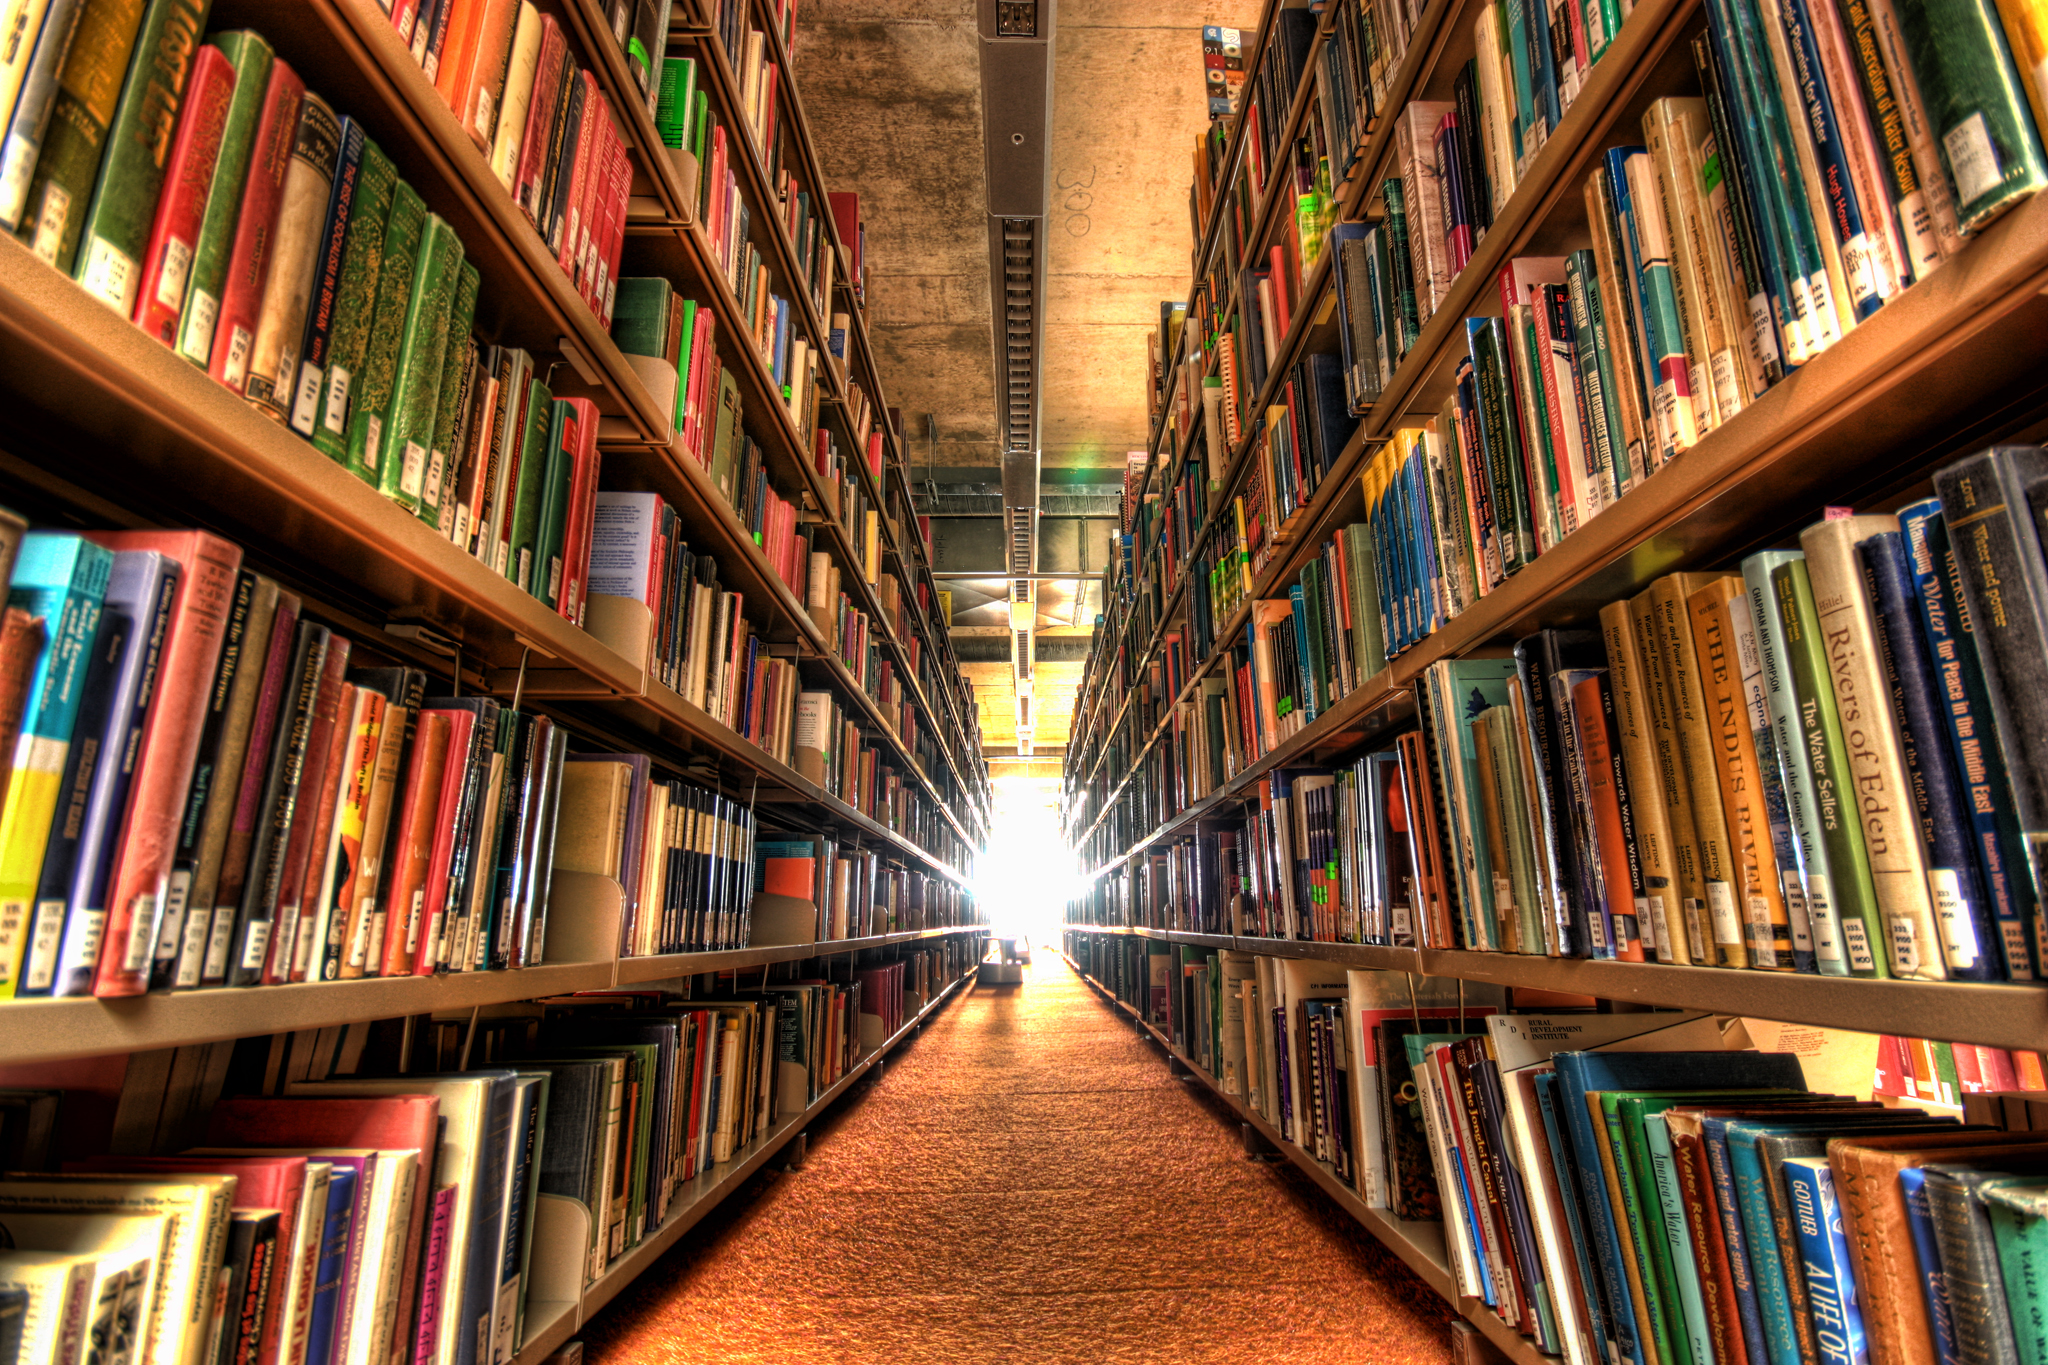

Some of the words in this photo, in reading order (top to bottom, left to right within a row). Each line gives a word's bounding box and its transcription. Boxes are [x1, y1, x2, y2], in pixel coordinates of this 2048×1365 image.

[1847, 0, 1871, 27] and
[1785, 23, 1814, 85] Planning
[1854, 21, 1893, 100] Conservation
[1802, 79, 1819, 103] for
[1875, 95, 1898, 114] of
[1807, 99, 1830, 144] Water
[1879, 108, 1909, 151] Water
[343, 162, 356, 181] THE
[1404, 157, 1417, 207] WATER
[1823, 163, 1844, 200] Hugh
[338, 180, 352, 203] RISE
[335, 203, 348, 219] OF
[1410, 208, 1420, 231] IN
[1832, 197, 1855, 241] Howes
[324, 219, 345, 275] SOCIALISM
[1412, 233, 1425, 283] CRISIS
[322, 275, 335, 288] IN
[313, 288, 332, 330] BRITAIN
[1588, 288, 1601, 324] WATSAN
[1595, 324, 1605, 350] 2000
[1533, 297, 1549, 362] RAINWATER
[1543, 363, 1561, 435] HARVESTING
[1587, 369, 1600, 395] WATER
[1573, 375, 1581, 394] First
[1576, 395, 1585, 422] People
[1591, 394, 1607, 437] RESOURCES
[1580, 424, 1588, 442] Poor
[1468, 409, 1478, 442] Designing
[1477, 469, 1486, 496] demand
[1583, 443, 1594, 473] Putting
[1903, 515, 1936, 575] Managing
[1972, 524, 1992, 562] Water
[1982, 561, 1999, 587] and
[235, 578, 254, 607] Left
[1751, 587, 1767, 626] CHAPMAN
[1816, 594, 1843, 609] Hillel
[1919, 574, 1952, 637] Water
[1985, 587, 2006, 629] power
[66, 609, 80, 633] and
[74, 600, 92, 640] Social
[86, 607, 99, 632] The
[233, 607, 247, 621] in
[1643, 614, 1653, 637] Water
[1663, 599, 1675, 624] Water
[59, 635, 74, 659] the
[228, 622, 244, 644] the
[1611, 625, 1621, 648] Water
[1648, 639, 1656, 653] and
[1668, 625, 1678, 641] and
[1759, 627, 1770, 645] AND
[1874, 613, 1899, 681] International
[1935, 638, 1957, 660] for
[1615, 649, 1624, 663] and
[1650, 655, 1661, 679] Power
[1671, 642, 1683, 668] Power
[1763, 646, 1780, 693] THOMPSON
[57, 642, 82, 703] Economy
[212, 644, 239, 712] Wilderness
[1618, 665, 1629, 689] Power
[1827, 625, 1867, 721] Rivers
[1940, 660, 1968, 701] Peace
[368, 695, 378, 714] David
[1602, 691, 1612, 714] IYER
[1655, 680, 1668, 719] Resources
[1676, 669, 1691, 710] Resources
[1705, 618, 1727, 685] THE
[1717, 693, 1746, 793] INDUS
[1530, 662, 1542, 701] WATER
[1536, 705, 1550, 771] RESOURCES
[1623, 690, 1635, 728] Resources
[1684, 711, 1693, 722] of
[1800, 697, 1819, 728] The
[1891, 687, 1910, 726] Waters
[1951, 700, 1971, 715] in
[289, 715, 310, 750] COLE
[1629, 728, 1637, 739] of
[1662, 721, 1670, 731] of
[1752, 684, 1773, 760] economics
[1768, 764, 1779, 779] of
[1777, 715, 1791, 747] Water
[1901, 730, 1913, 744] of
[1954, 715, 1977, 738] the
[1783, 748, 1795, 768] and
[1807, 730, 1829, 776] Water
[1848, 726, 1877, 768] of
[1905, 748, 1919, 766] the
[1959, 737, 1988, 784] Middle
[359, 760, 368, 775] Left
[1787, 770, 1799, 788] the
[353, 784, 364, 810] Britain
[1817, 777, 1840, 830] Sellers
[1910, 770, 1930, 812] Middle
[1970, 783, 1995, 815] East
[1612, 753, 1626, 801] Towards
[1620, 804, 1633, 840] Water
[1627, 843, 1641, 891] Wisdom
[1791, 790, 1807, 828] Ganges
[1857, 770, 1898, 856] Eden
[1921, 817, 1937, 843] East
[1800, 831, 1815, 863] Valley
[1981, 831, 2002, 872] Masahiro
[1991, 872, 2011, 916] Murakami
[1499, 1019, 1506, 1027] R
[1530, 1026, 1583, 1034] DEVELOPMENT
[1531, 1033, 1570, 1041] INSTITUTE
[1463, 1078, 1476, 1106] The
[527, 1104, 537, 1125] The
[525, 1128, 535, 1150] Life
[1469, 1107, 1487, 1158] Jonglei
[523, 1152, 532, 1164] of
[1708, 1137, 1728, 1188] drought
[510, 1162, 524, 1206] JEAN
[1480, 1159, 1497, 1204] Canal
[1654, 1150, 1677, 1209] America's
[1680, 1145, 1698, 1195] Water
[1690, 1200, 1713, 1274] Resource
[1719, 1186, 1736, 1213] and
[1791, 1177, 1819, 1238] GOTTLIEB
[1587, 1171, 1613, 1262] ENVIRONMENTAL
[1608, 1266, 1624, 1315] QUALITY
[1613, 1139, 1633, 1207] Interbasin
[1627, 1210, 1650, 1280] Transfers
[1642, 1282, 1652, 1299] of
[1647, 1299, 1662, 1344] Water
[1665, 1209, 1686, 1247] Water
[1723, 1212, 1741, 1250] water
[1776, 1215, 1789, 1239] The
[1730, 1248, 1749, 1294] supply
[1750, 1175, 1771, 1245] Water
[1766, 1249, 1791, 1351] Resource
[1781, 1242, 1801, 1306] Economic
[1805, 1260, 1832, 1281] A
[1808, 1278, 1843, 1323] LIFE
[1818, 1327, 1848, 1365] OF
